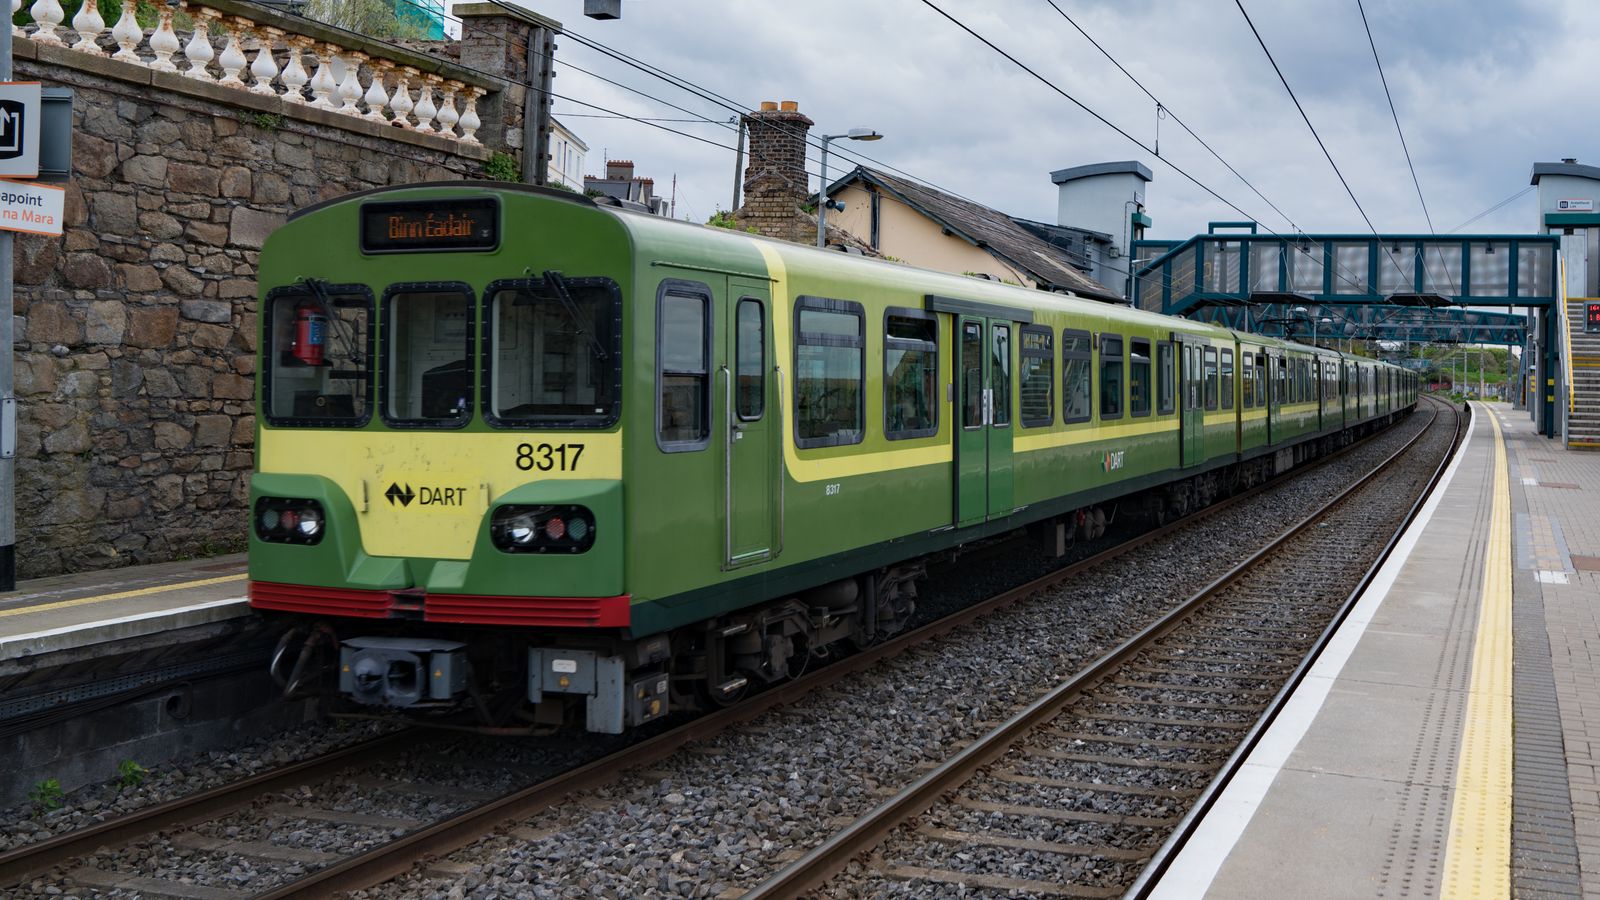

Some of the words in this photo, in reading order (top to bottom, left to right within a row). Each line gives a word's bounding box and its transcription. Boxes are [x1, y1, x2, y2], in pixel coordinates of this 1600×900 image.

[3, 209, 18, 220] na
[22, 209, 54, 225] Mara
[388, 215, 422, 239] Binn
[515, 443, 585, 472] 8317
[1110, 451, 1125, 470] DART
[419, 486, 467, 506] DART
[825, 483, 841, 496] 8317
